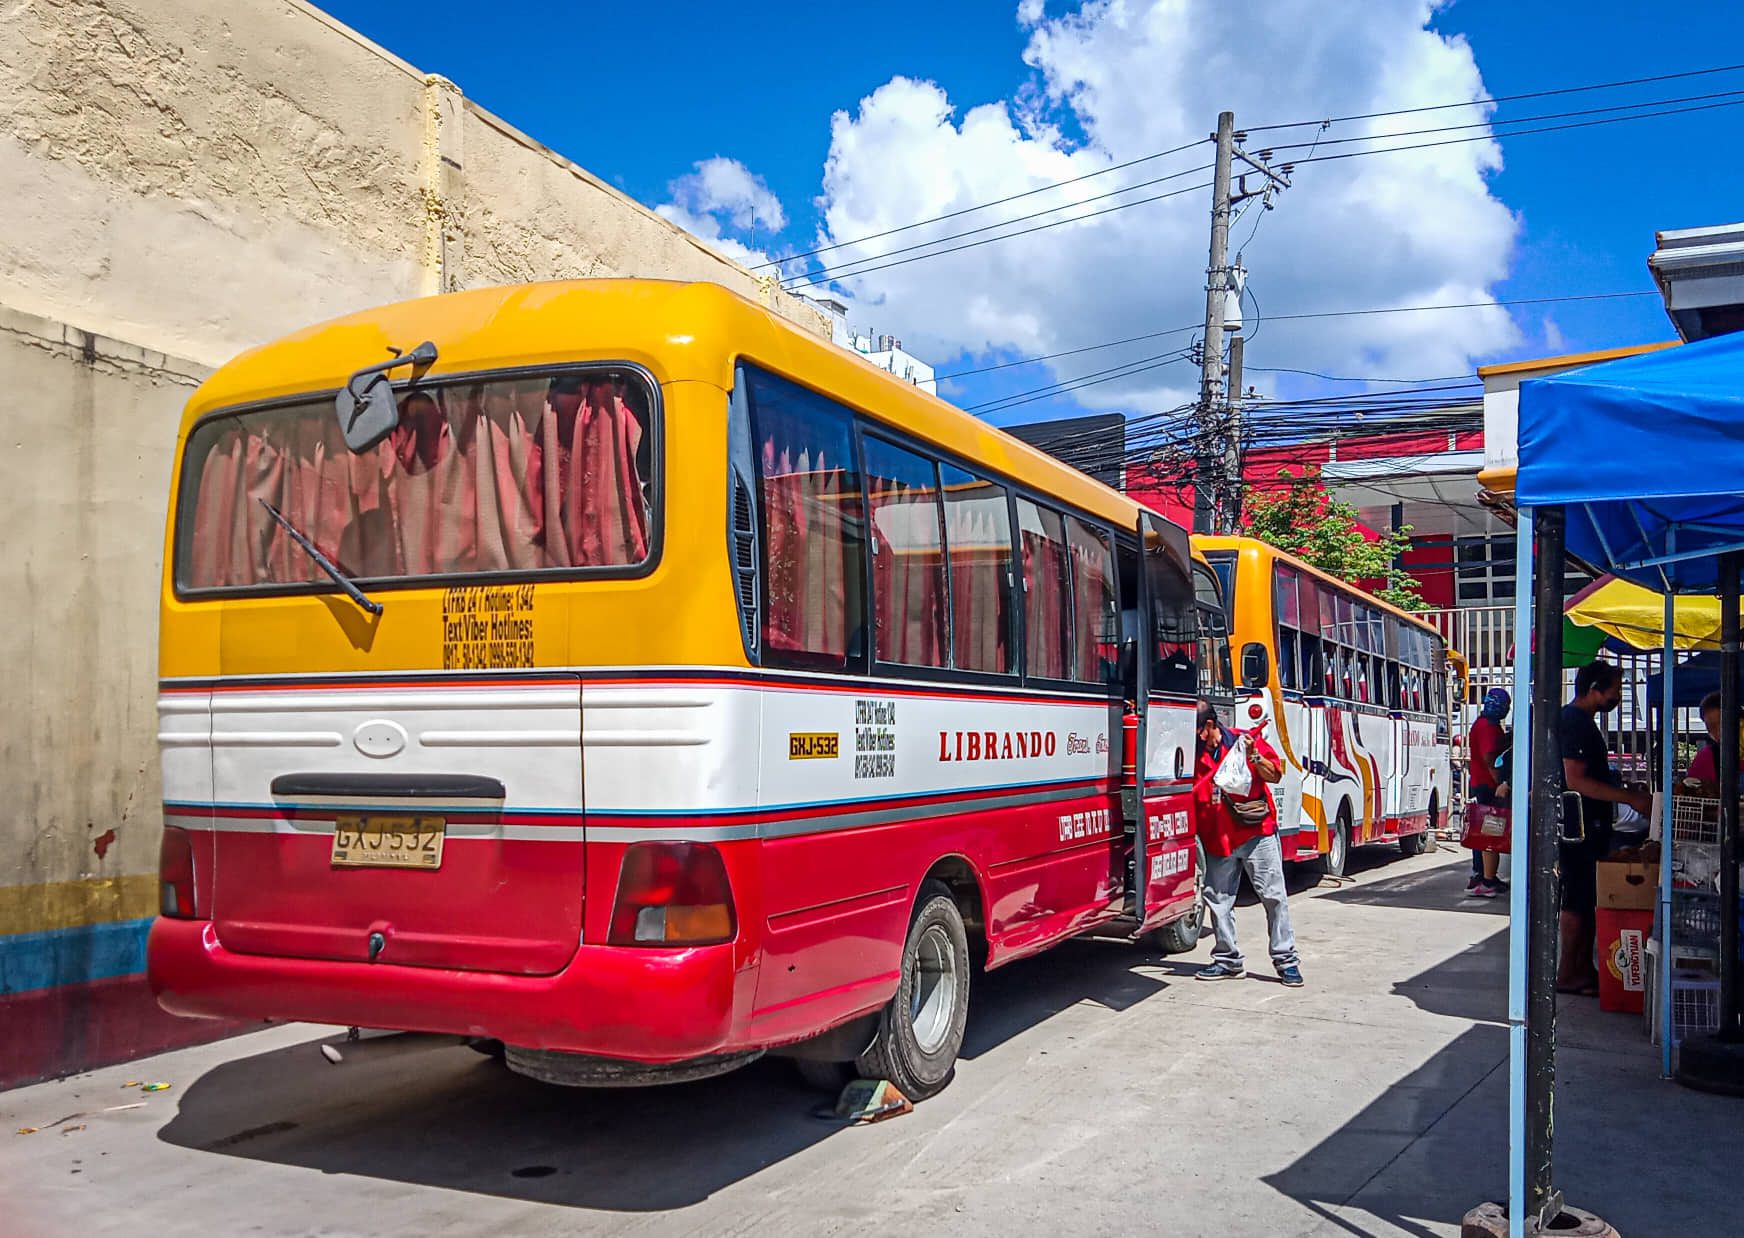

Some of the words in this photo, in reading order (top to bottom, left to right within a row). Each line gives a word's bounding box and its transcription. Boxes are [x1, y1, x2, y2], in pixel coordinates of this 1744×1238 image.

[491, 612, 533, 641] Hotlines:
[939, 731, 1056, 761] LIBRANDO
[337, 820, 384, 850] GXJ
[389, 821, 436, 851] 532
